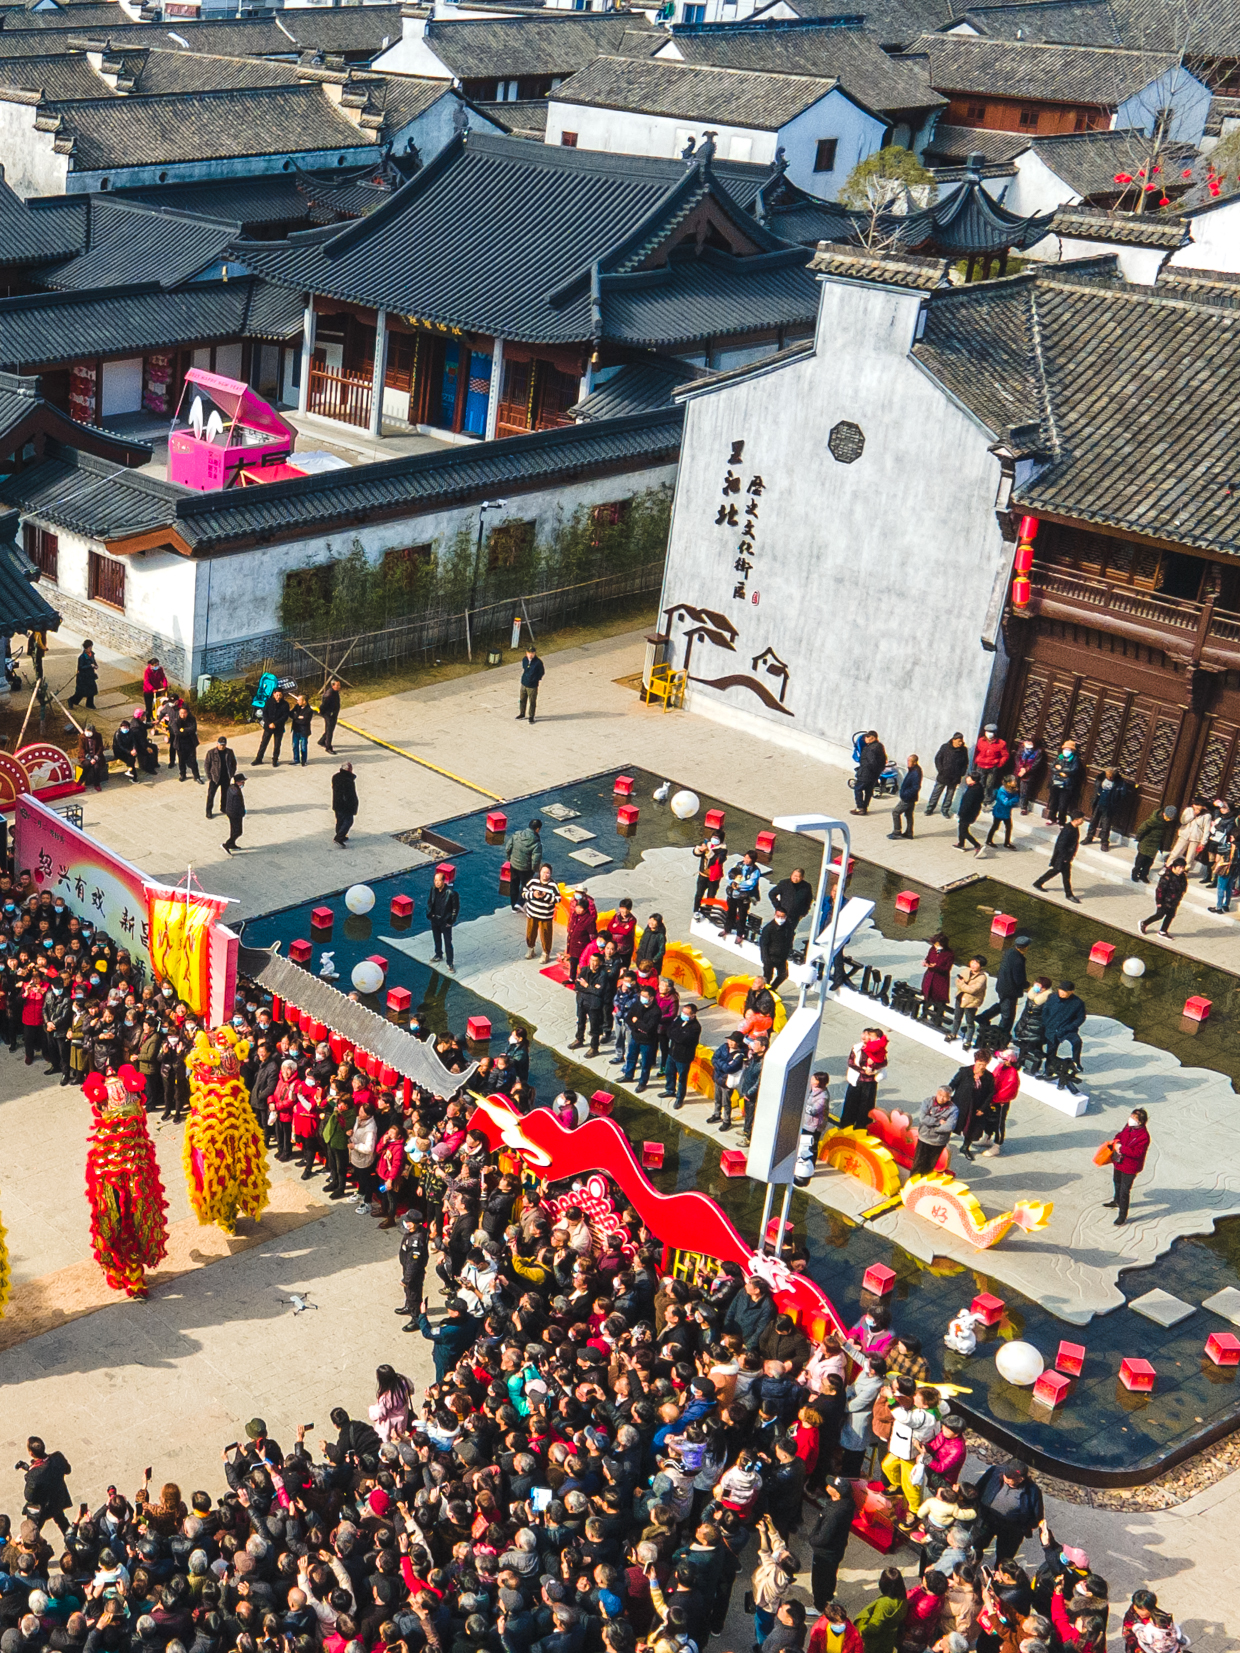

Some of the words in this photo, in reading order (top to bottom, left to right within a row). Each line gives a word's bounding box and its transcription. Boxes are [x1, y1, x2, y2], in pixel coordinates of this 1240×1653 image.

[39, 847, 106, 918] 绍兴有戏
[931, 1205, 948, 1224] 好
